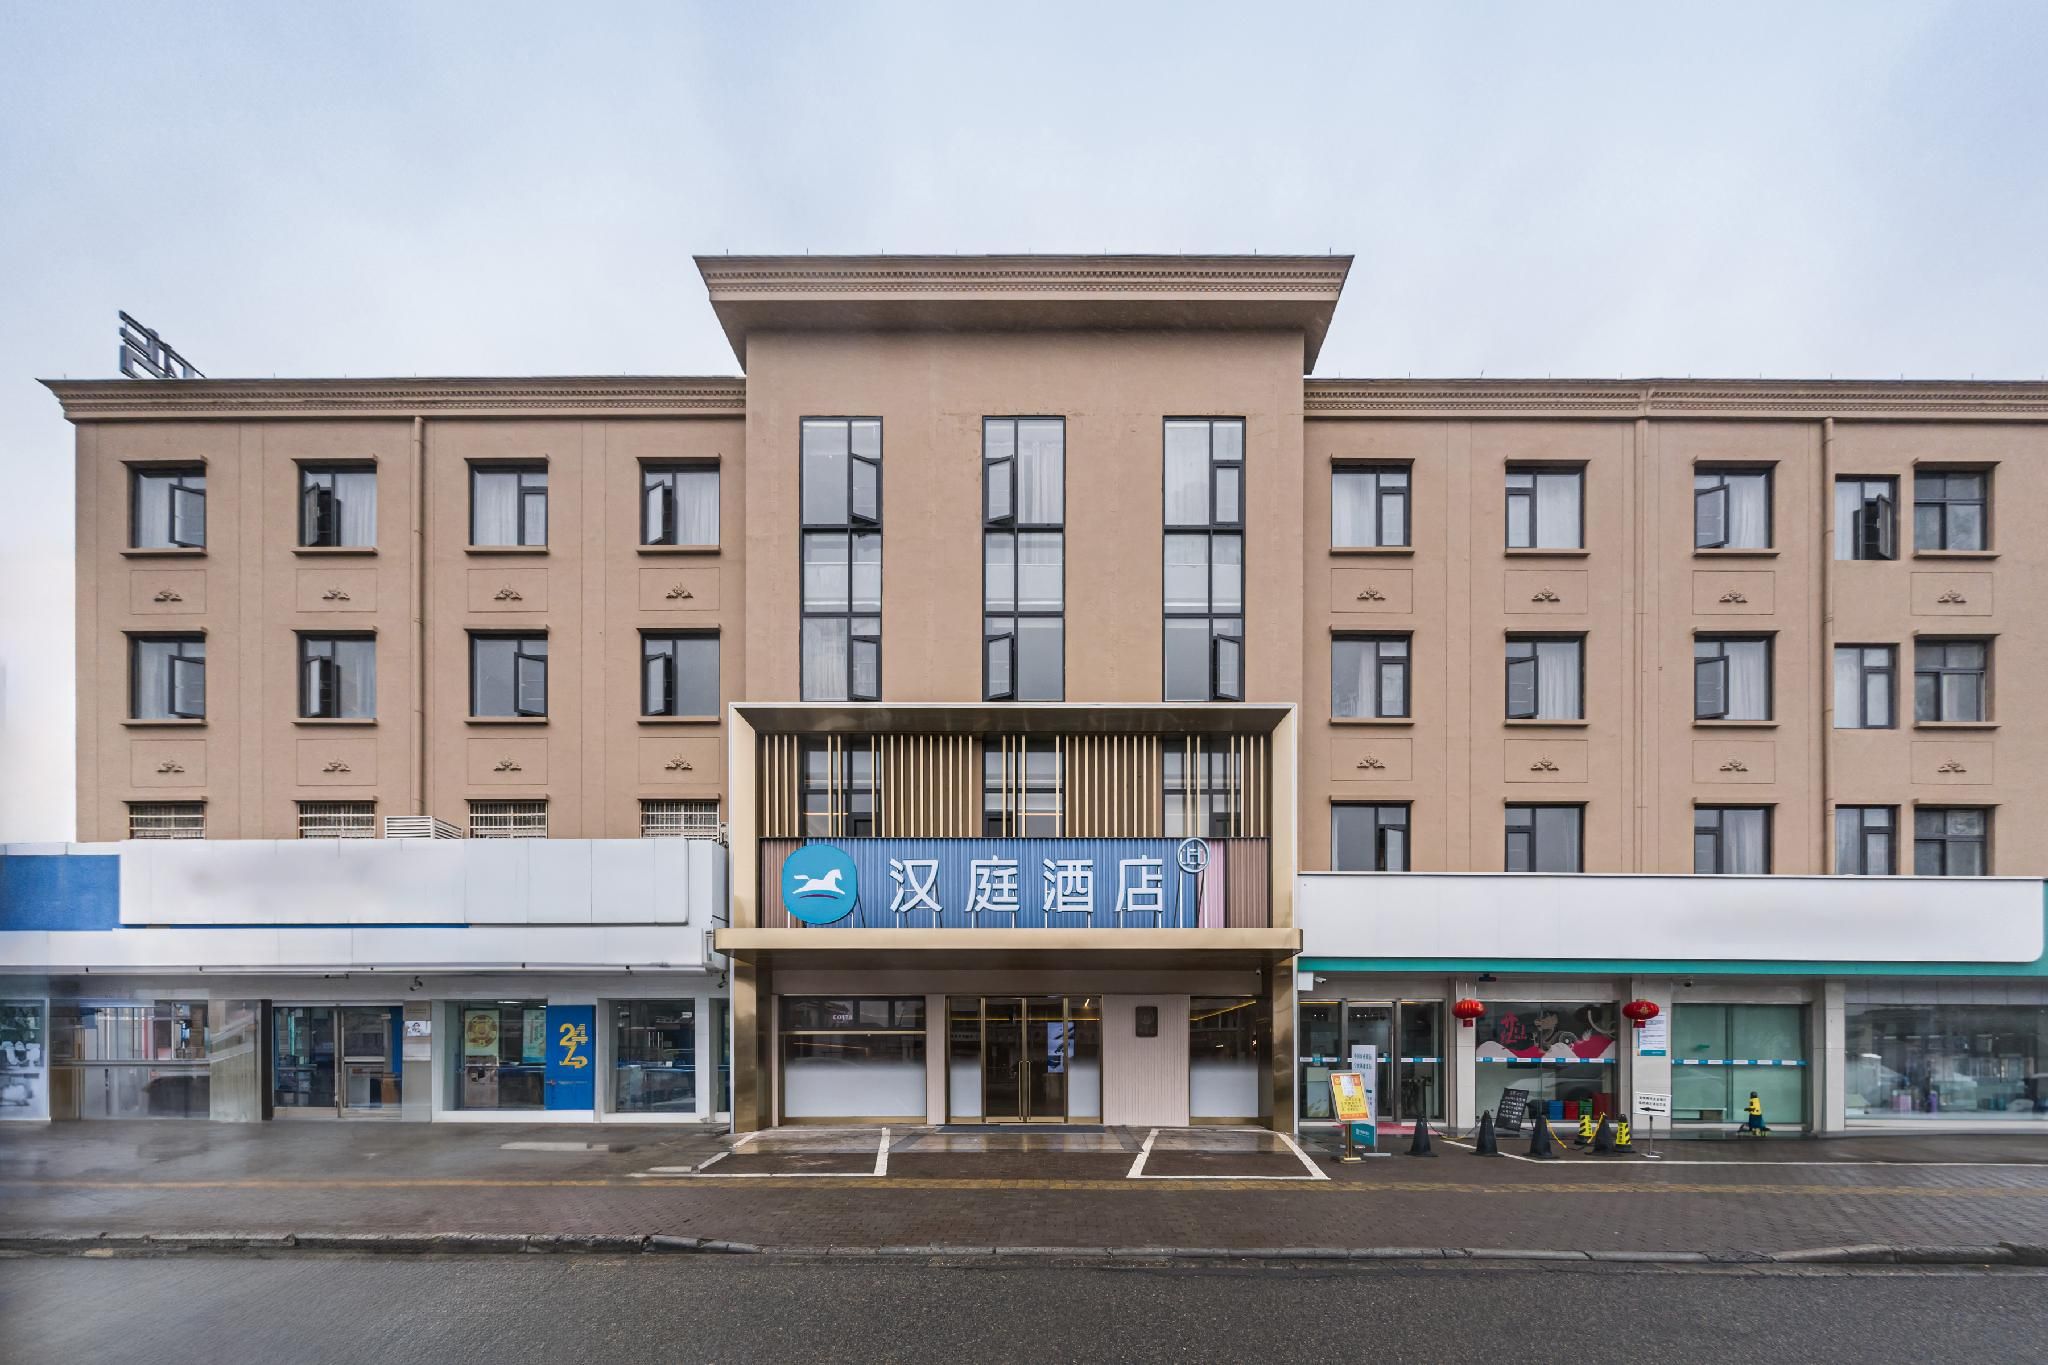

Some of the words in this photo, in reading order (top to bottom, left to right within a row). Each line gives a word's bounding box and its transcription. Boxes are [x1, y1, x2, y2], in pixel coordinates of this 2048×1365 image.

[889, 855, 1163, 912] 汉庭酒店
[559, 1023, 588, 1046] 24
